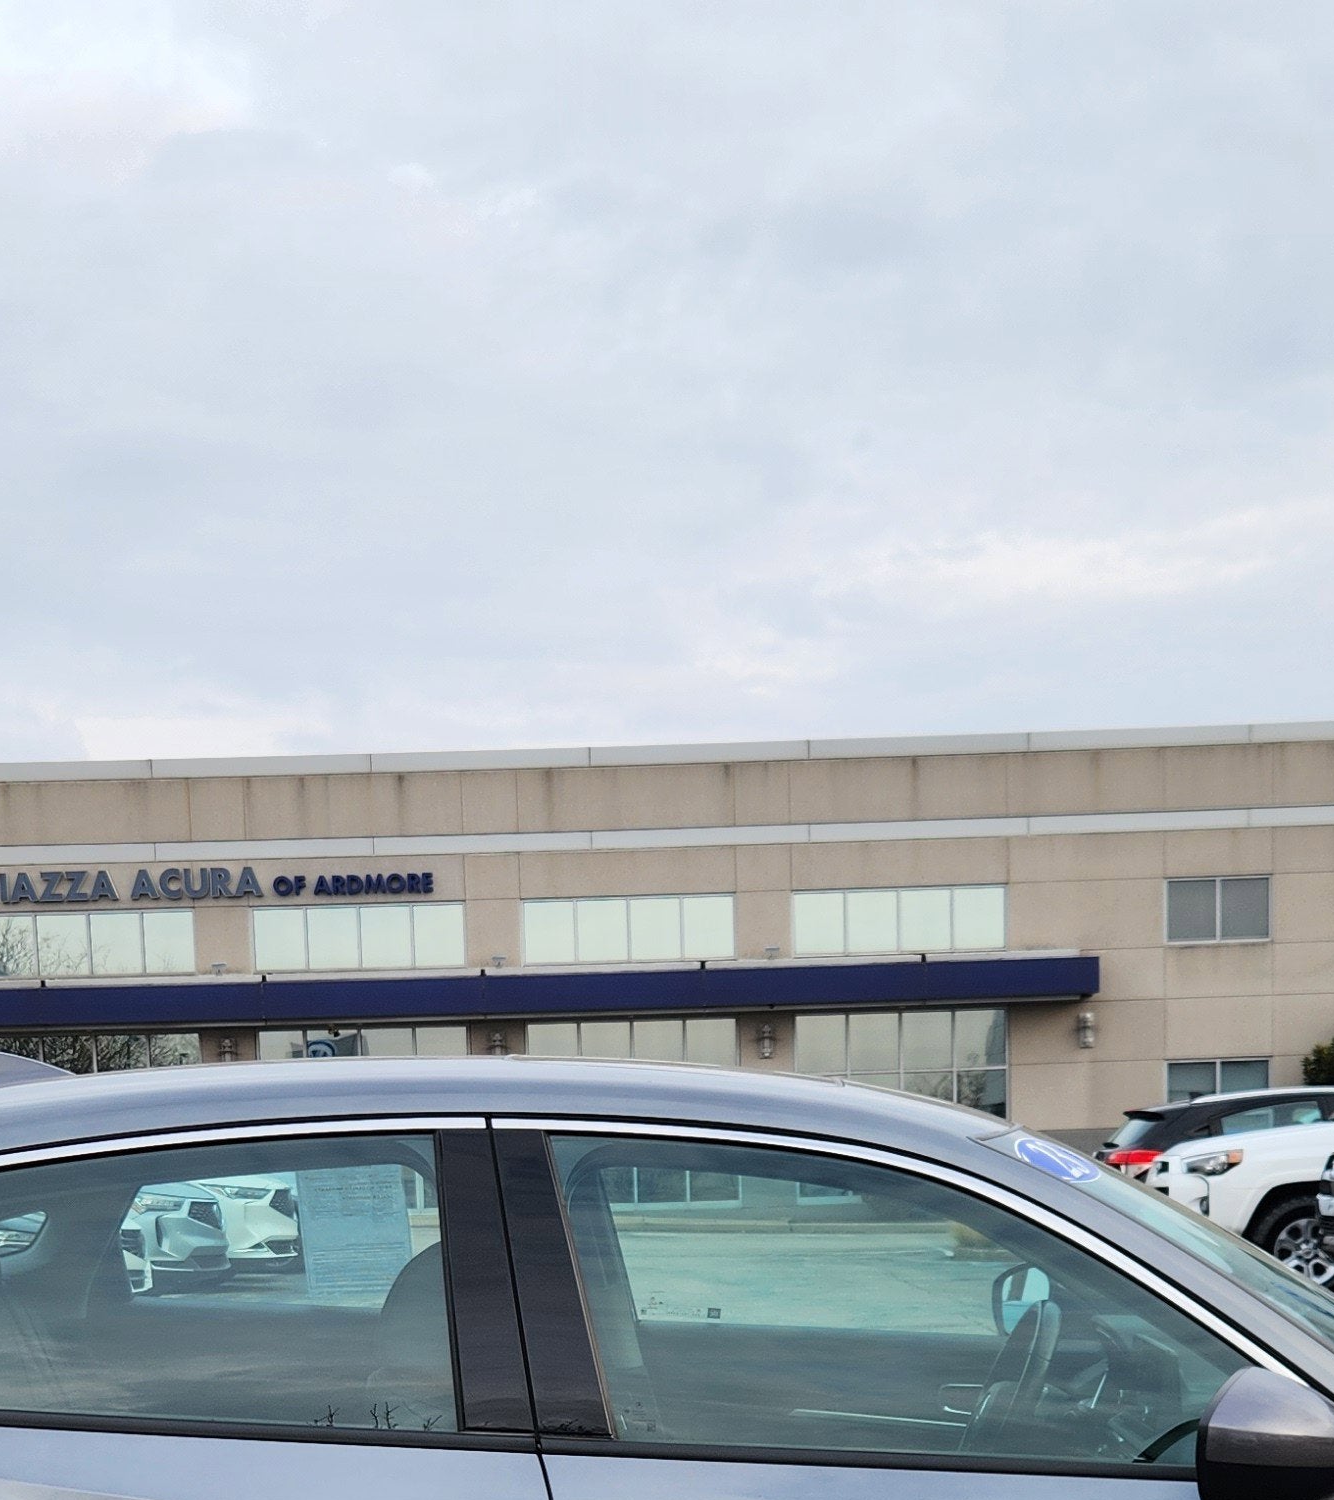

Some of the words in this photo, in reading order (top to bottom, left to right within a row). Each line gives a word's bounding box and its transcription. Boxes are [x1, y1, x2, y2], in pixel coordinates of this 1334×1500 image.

[131, 866, 263, 900] ACURA
[272, 875, 306, 897] OF
[313, 871, 435, 896] ARDMORE
